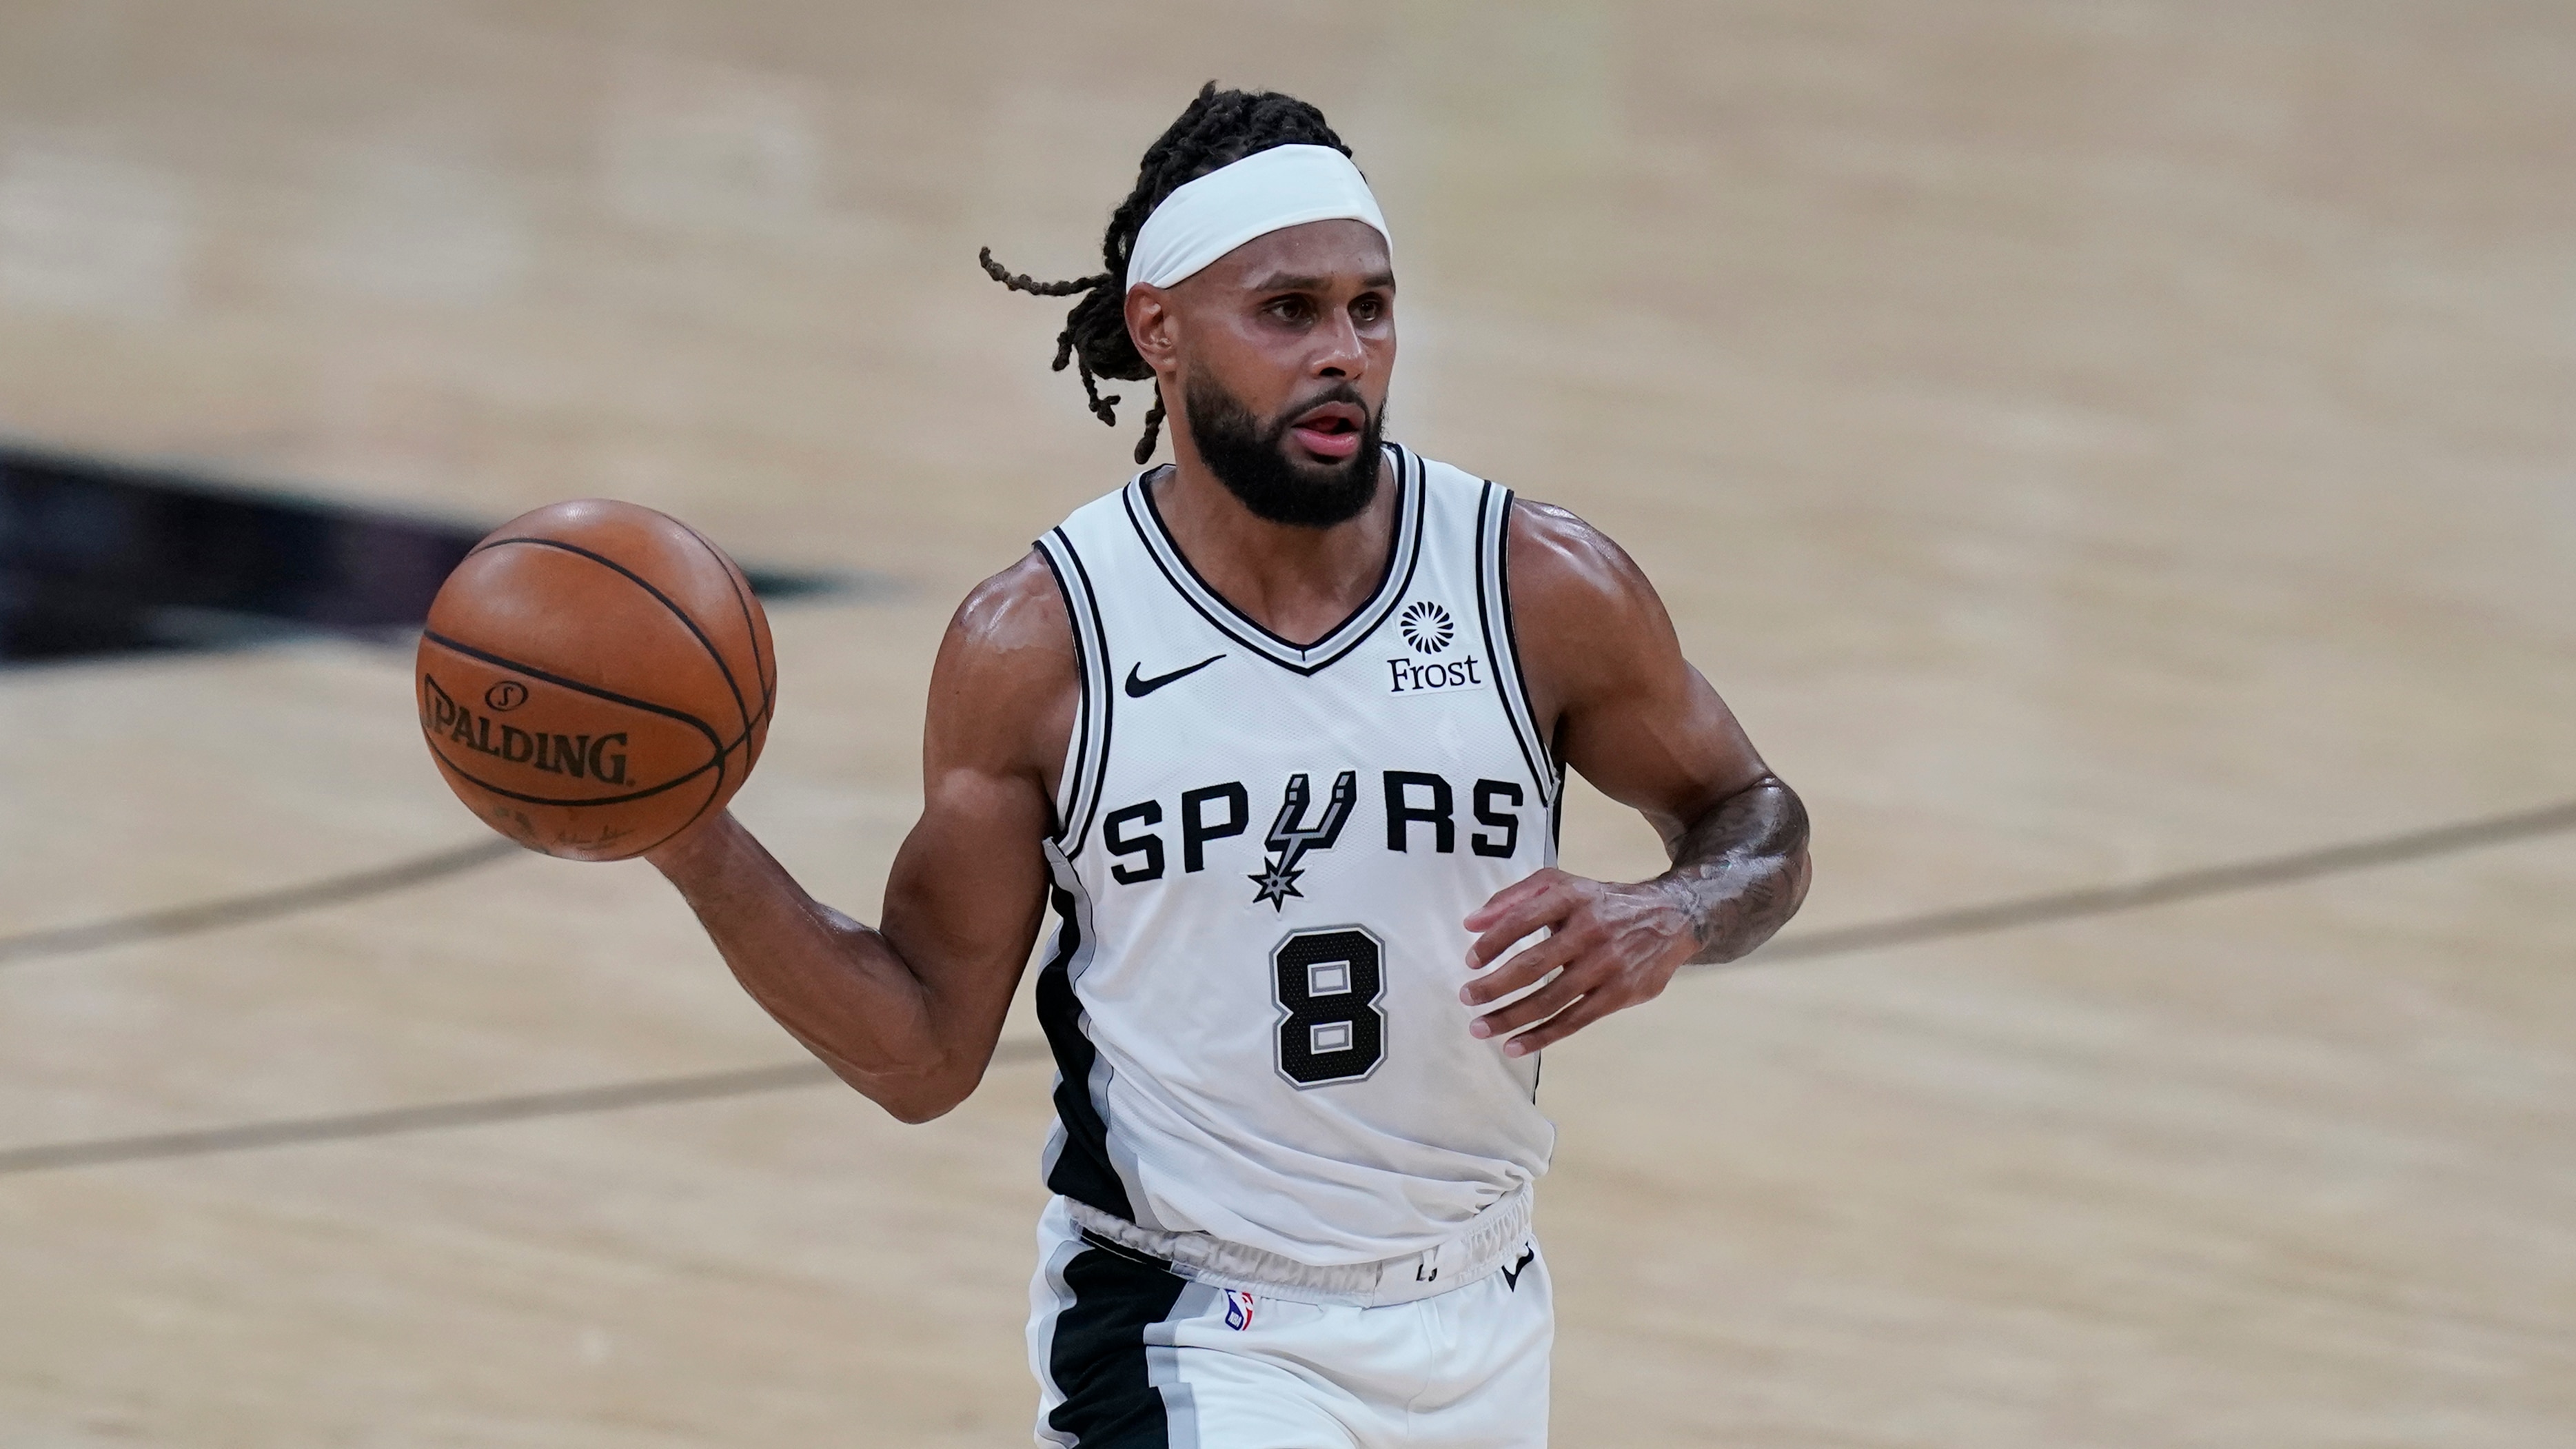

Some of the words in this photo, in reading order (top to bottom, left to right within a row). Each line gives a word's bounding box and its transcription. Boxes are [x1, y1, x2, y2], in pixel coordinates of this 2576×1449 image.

[1386, 654, 1481, 692] Frost
[1103, 770, 1524, 912] SPURS
[1269, 923, 1388, 1091] 8
